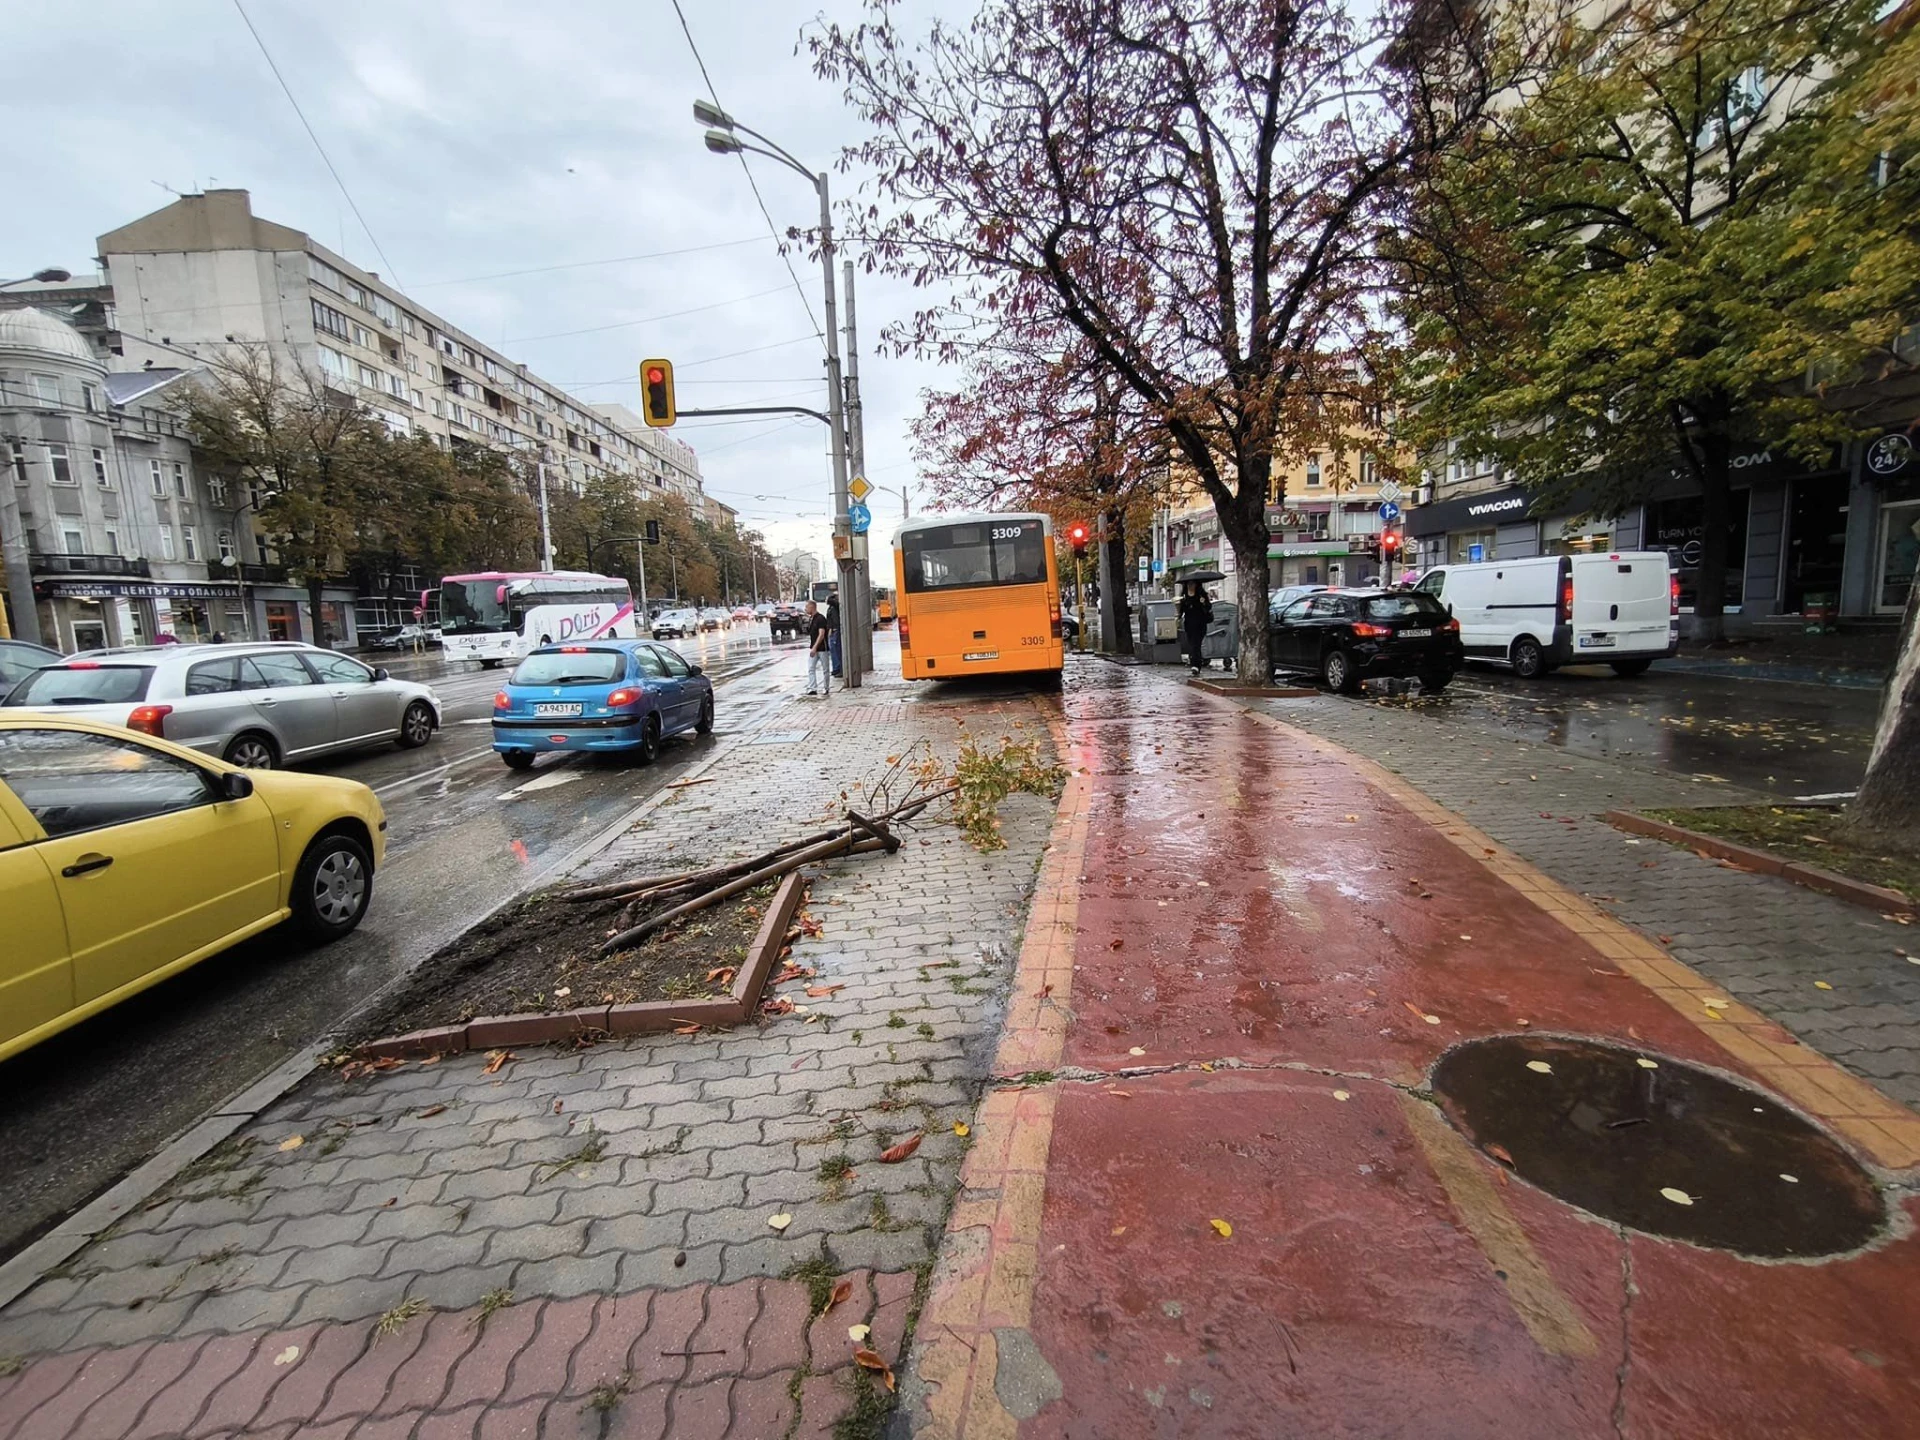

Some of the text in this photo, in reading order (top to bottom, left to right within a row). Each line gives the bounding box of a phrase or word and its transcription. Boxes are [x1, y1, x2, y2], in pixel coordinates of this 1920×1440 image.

[1874, 453, 1906, 469] 24/
[1468, 498, 1523, 516] VIVACOM
[991, 526, 1021, 539] 3309
[120, 585, 169, 596] ЦЕНТЪР
[173, 588, 186, 596] за
[559, 605, 600, 640] Doris
[1021, 636, 1045, 646] 3309
[538, 705, 549, 713] CA
[551, 704, 569, 713] 9431
